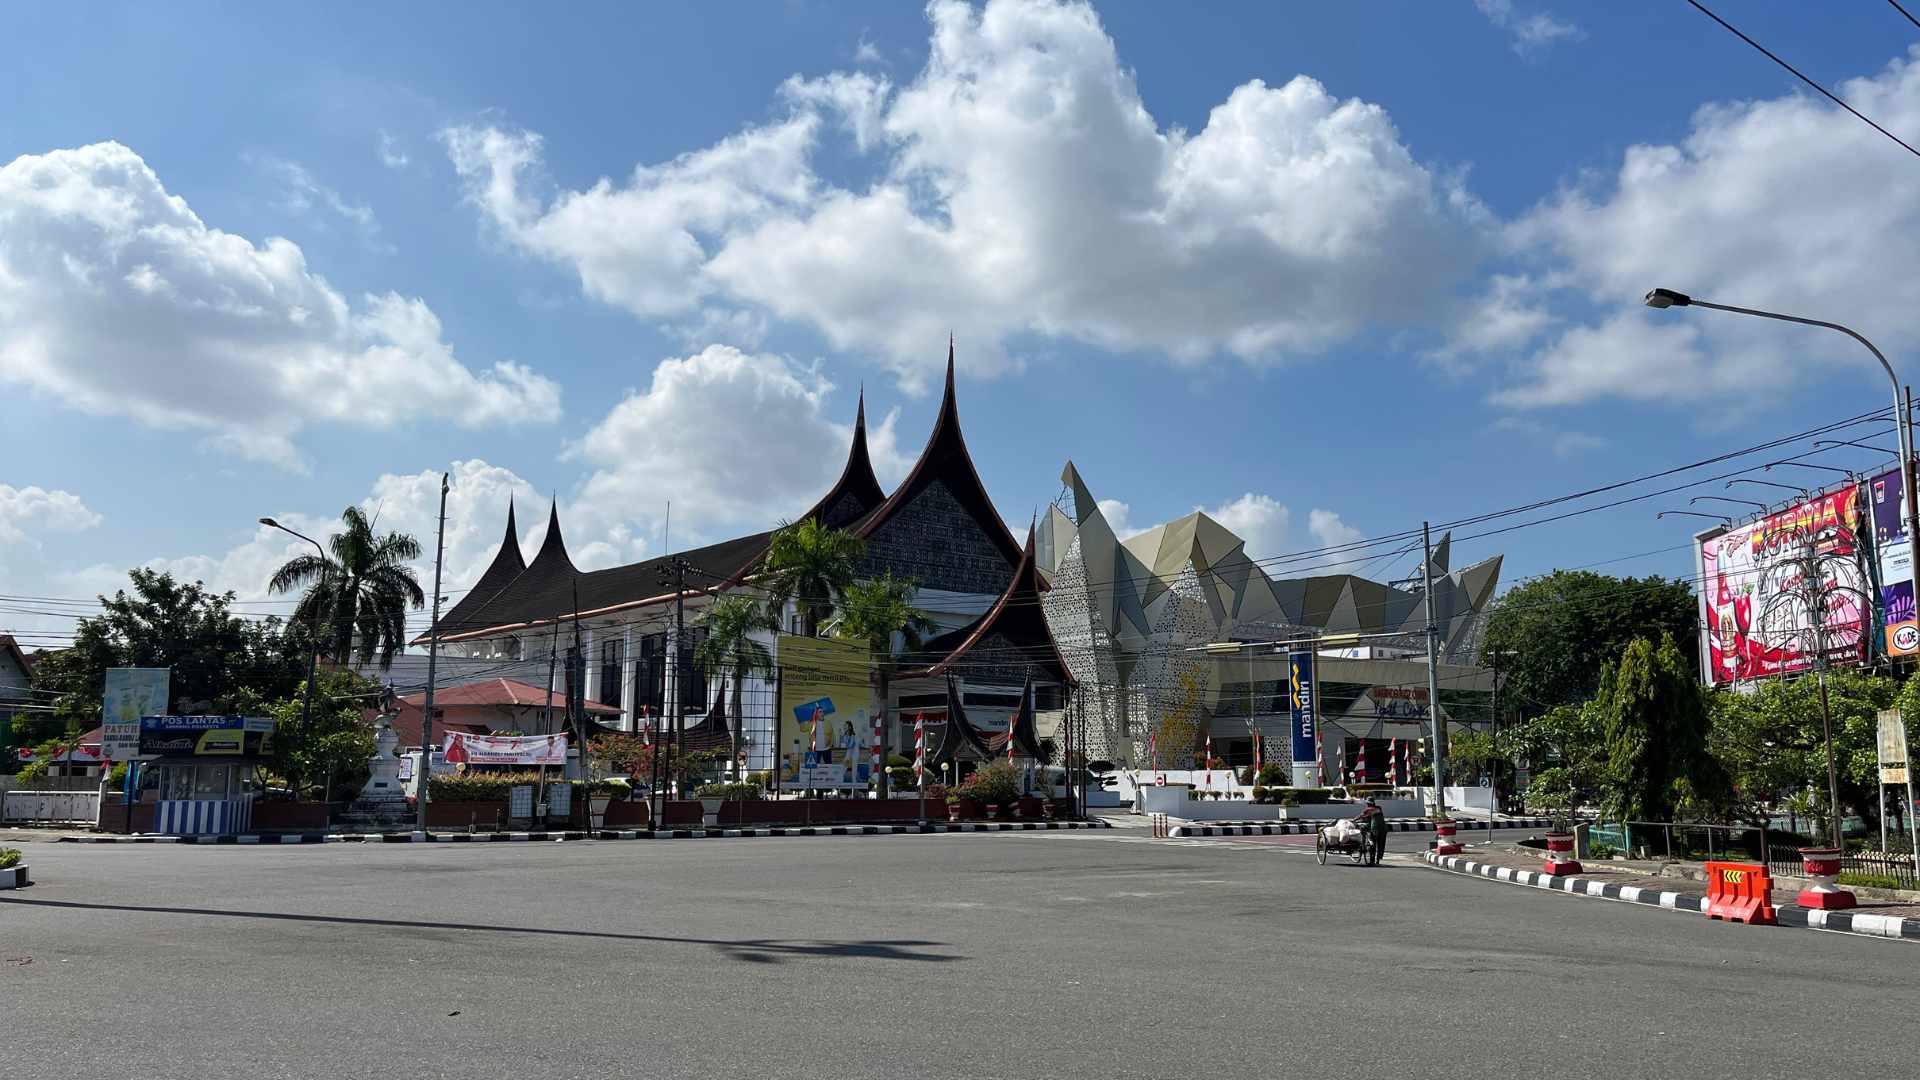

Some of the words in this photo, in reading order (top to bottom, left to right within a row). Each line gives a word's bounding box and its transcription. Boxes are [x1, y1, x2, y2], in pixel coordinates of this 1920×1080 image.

[161, 717, 182, 725] POS
[185, 717, 226, 726] LANTAS
[1298, 680, 1313, 738] mandiri
